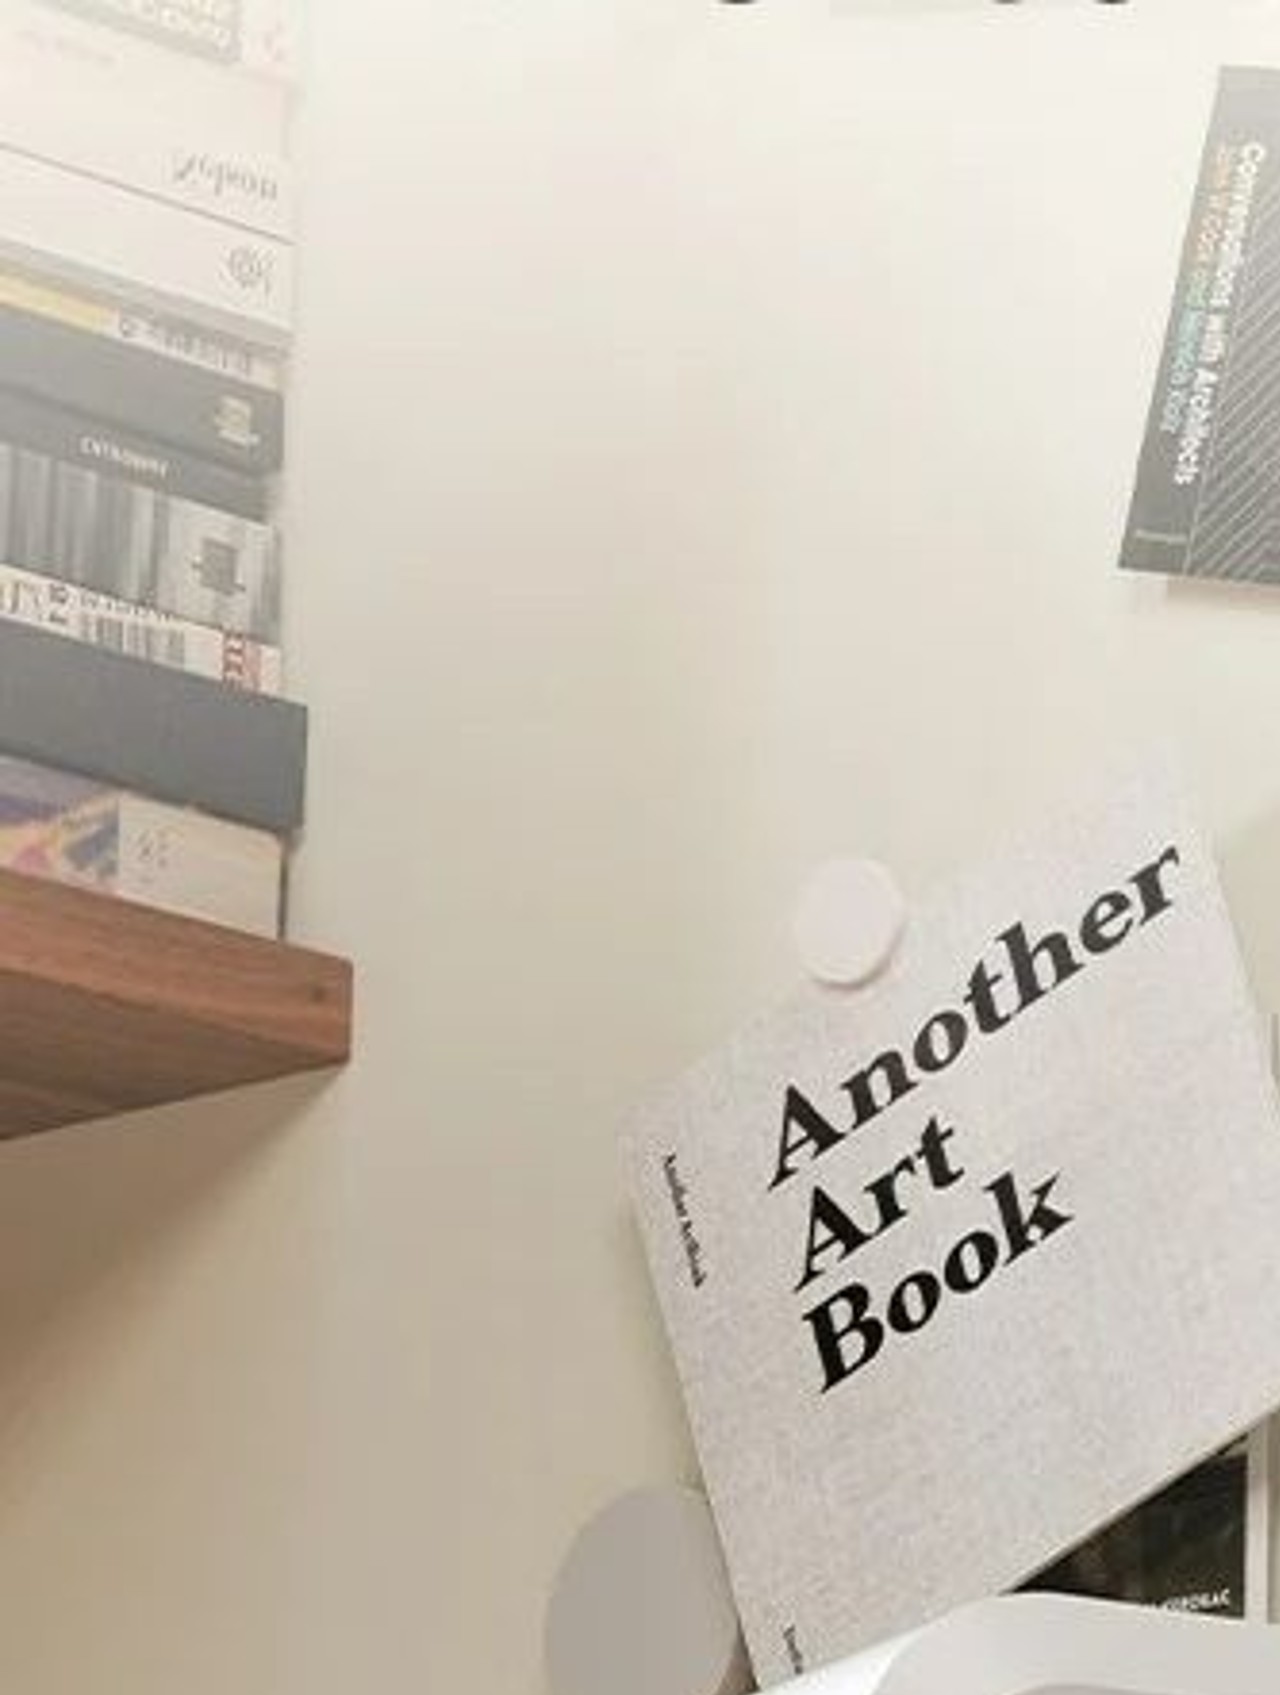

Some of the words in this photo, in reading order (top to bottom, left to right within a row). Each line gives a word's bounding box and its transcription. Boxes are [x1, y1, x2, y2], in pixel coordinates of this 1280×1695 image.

[768, 845, 1181, 1192] Another
[794, 1115, 966, 1292] Art
[801, 1170, 1075, 1394] Book
